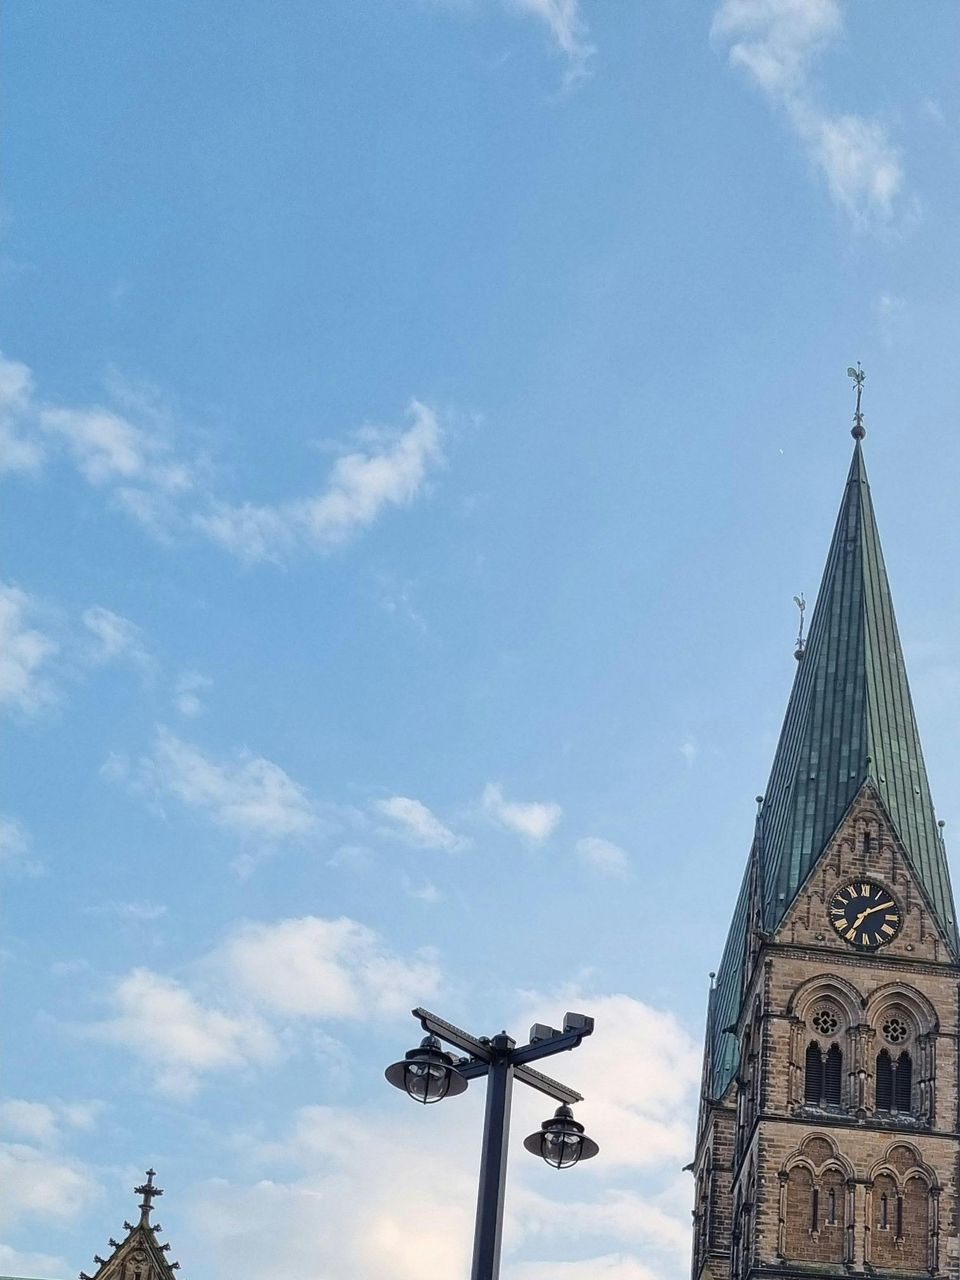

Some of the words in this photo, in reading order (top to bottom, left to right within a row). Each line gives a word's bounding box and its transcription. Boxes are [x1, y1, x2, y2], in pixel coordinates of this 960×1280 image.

[846, 885, 858, 899] XI
[861, 884, 870, 897] XII
[874, 890, 883, 900] I
[834, 894, 849, 905] X
[830, 906, 845, 915] IX
[862, 933, 870, 945] VI
[874, 932, 884, 944] V
